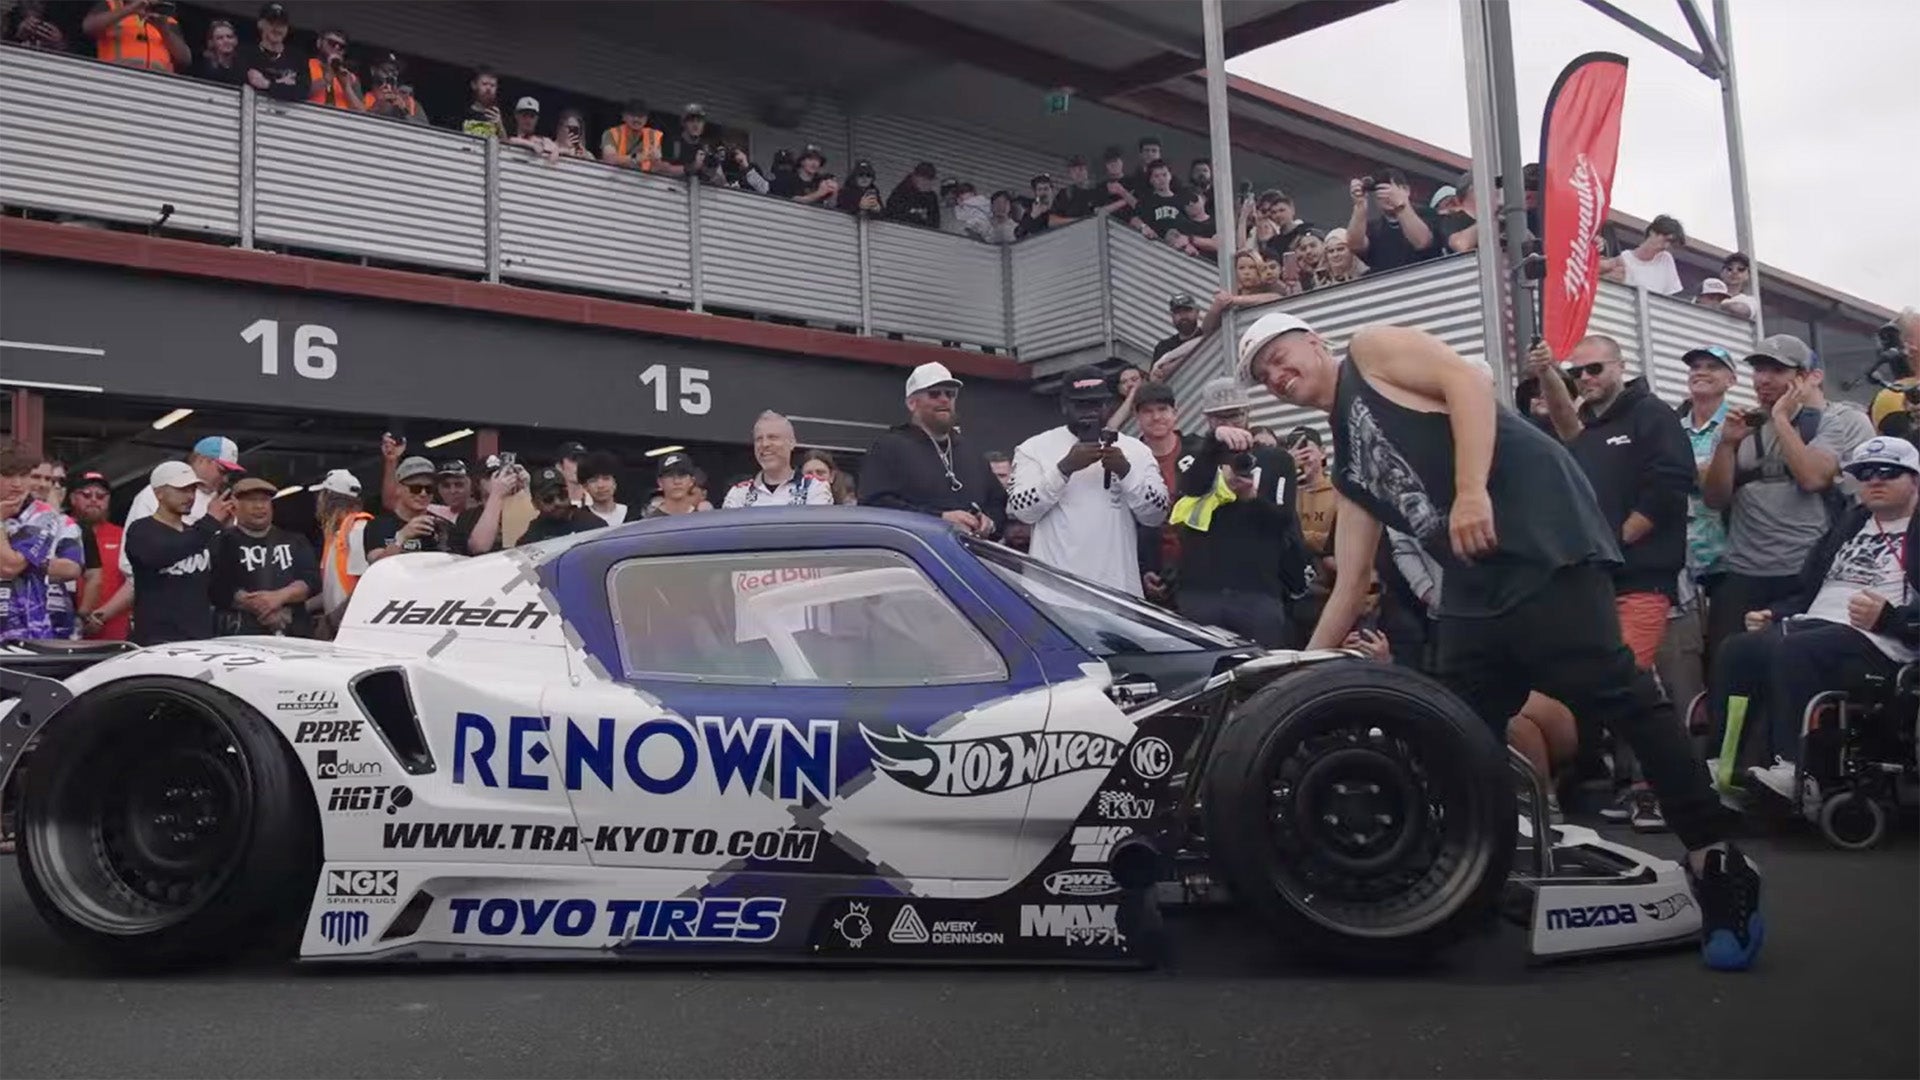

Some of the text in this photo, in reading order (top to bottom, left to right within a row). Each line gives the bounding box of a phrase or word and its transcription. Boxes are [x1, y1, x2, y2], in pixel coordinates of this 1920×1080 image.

[1563, 153, 1595, 301] Milwaukee
[240, 319, 338, 380] 16
[639, 364, 711, 415] 15
[737, 569, 777, 592] Red
[370, 600, 549, 630] Haltech
[453, 712, 837, 803] RENOWN
[328, 786, 390, 811] HGT
[1105, 799, 1155, 819] KW
[383, 822, 818, 860] WWW.TRA-KYOTO.COM
[328, 871, 398, 895] NGK
[1053, 874, 1117, 895] PWR
[449, 898, 786, 942] TOYO TIRES
[932, 921, 977, 932] AVERY
[1020, 904, 1120, 937] MAX
[932, 932, 1004, 944] DENNISON
[1065, 927, 1126, 946] ドリフト
